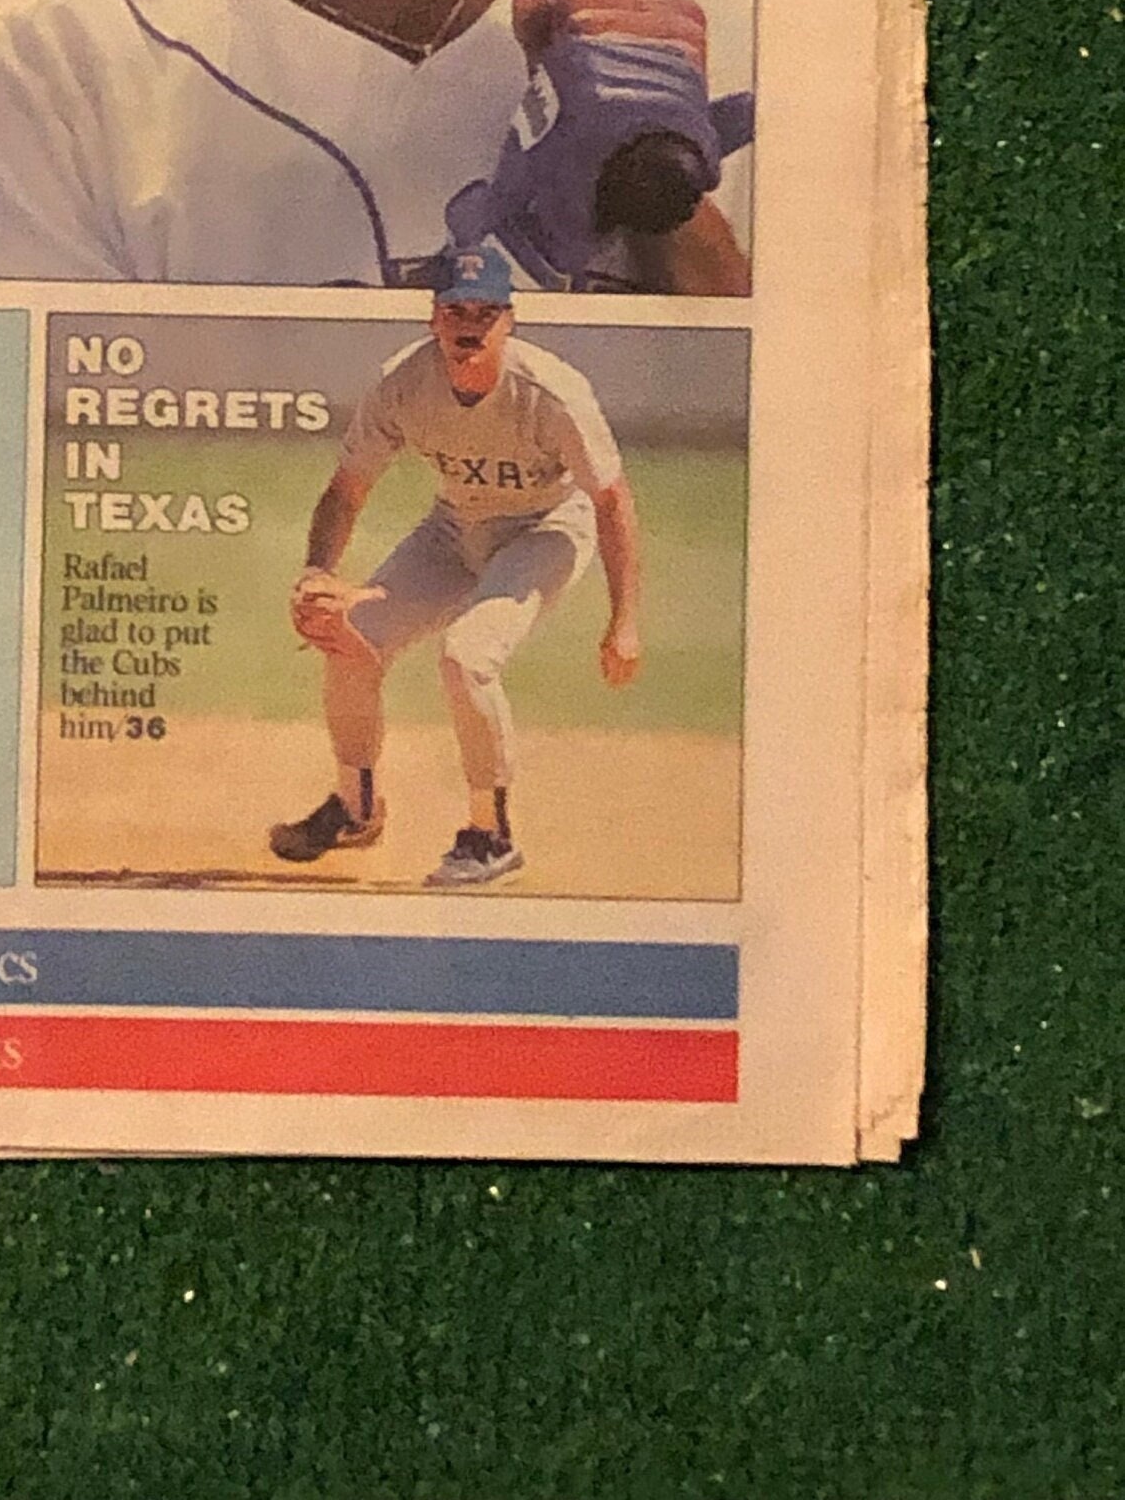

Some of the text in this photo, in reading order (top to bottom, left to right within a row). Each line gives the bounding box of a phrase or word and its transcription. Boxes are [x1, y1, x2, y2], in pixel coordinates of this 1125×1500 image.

[66, 336, 145, 376] NO
[65, 387, 330, 432] REGRETS
[65, 441, 121, 480] IN
[63, 491, 250, 534] TEXAS
[63, 553, 147, 580] Rafael
[62, 586, 218, 614] Palmeiro is
[60, 619, 213, 649] glad to put
[61, 649, 181, 677] the Cubs
[60, 682, 156, 708] behind
